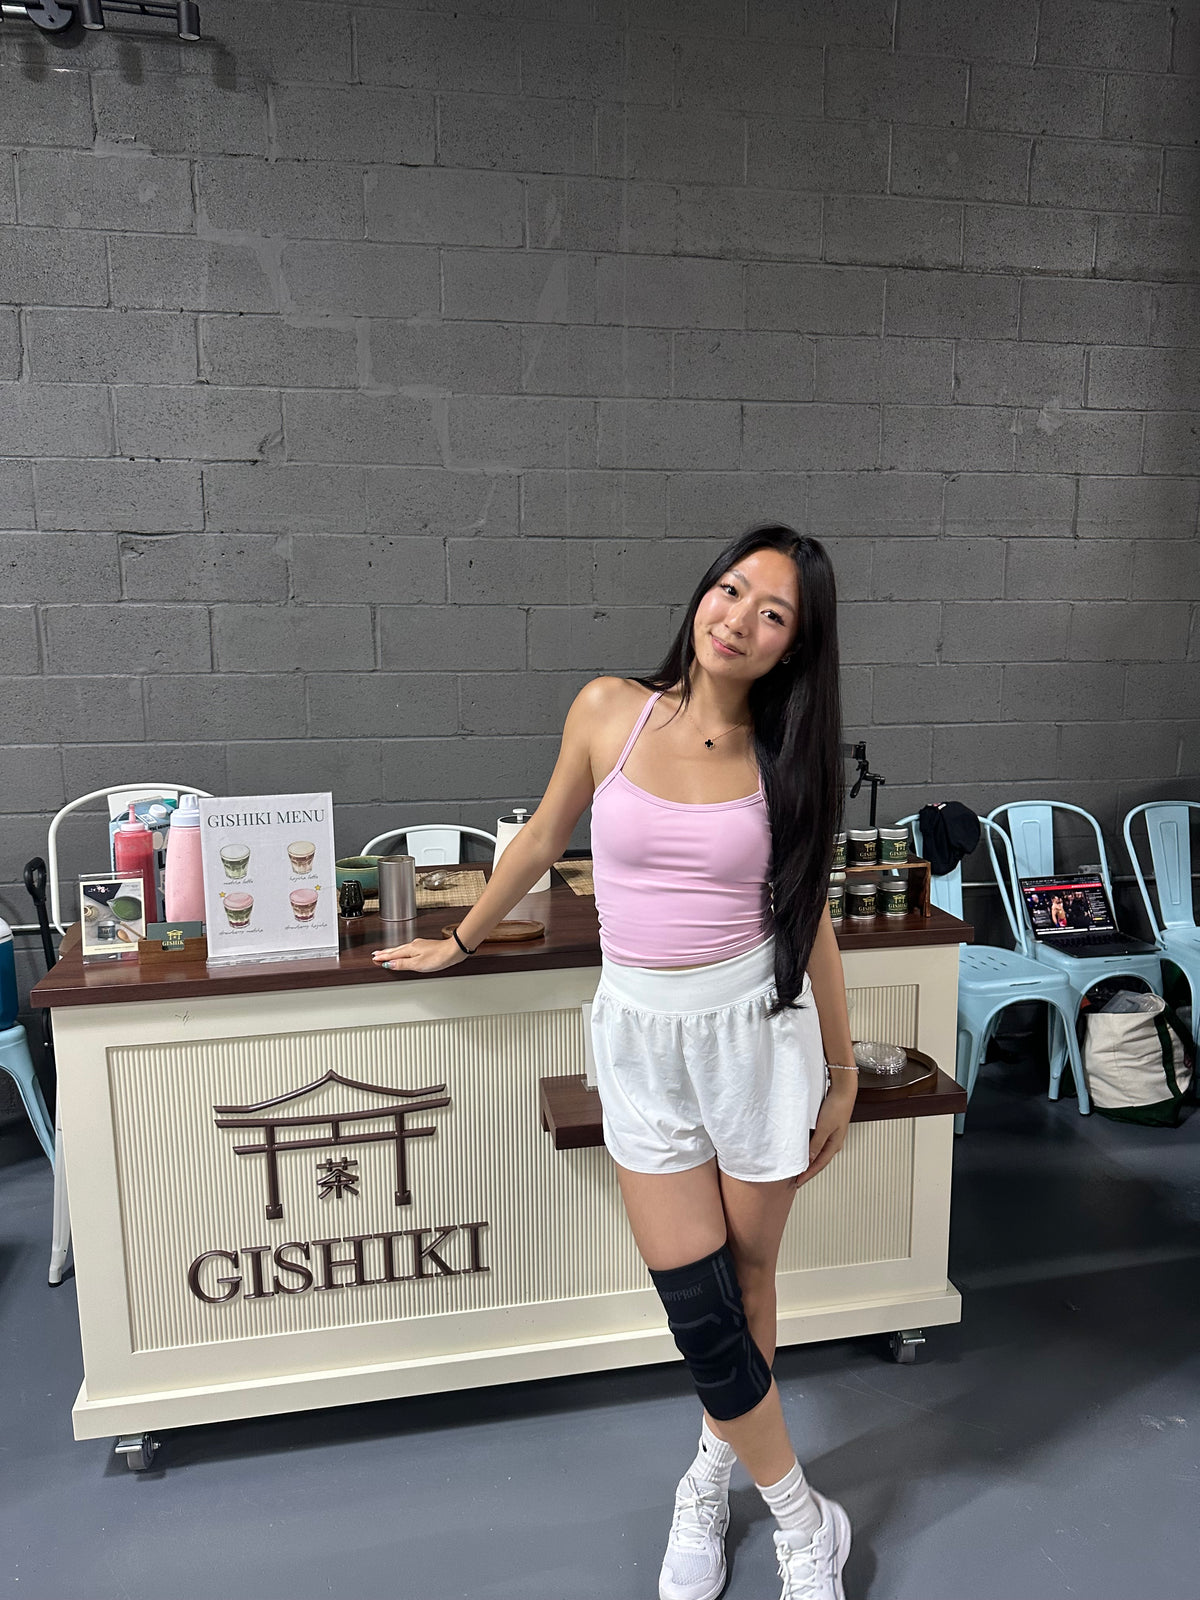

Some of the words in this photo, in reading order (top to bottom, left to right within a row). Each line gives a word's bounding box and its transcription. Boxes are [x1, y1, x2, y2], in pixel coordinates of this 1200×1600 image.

[207, 812, 271, 828] GISHIKI
[277, 809, 325, 824] MENU
[316, 1156, 359, 1200] 茶
[188, 1221, 490, 1304] GISHIKI
